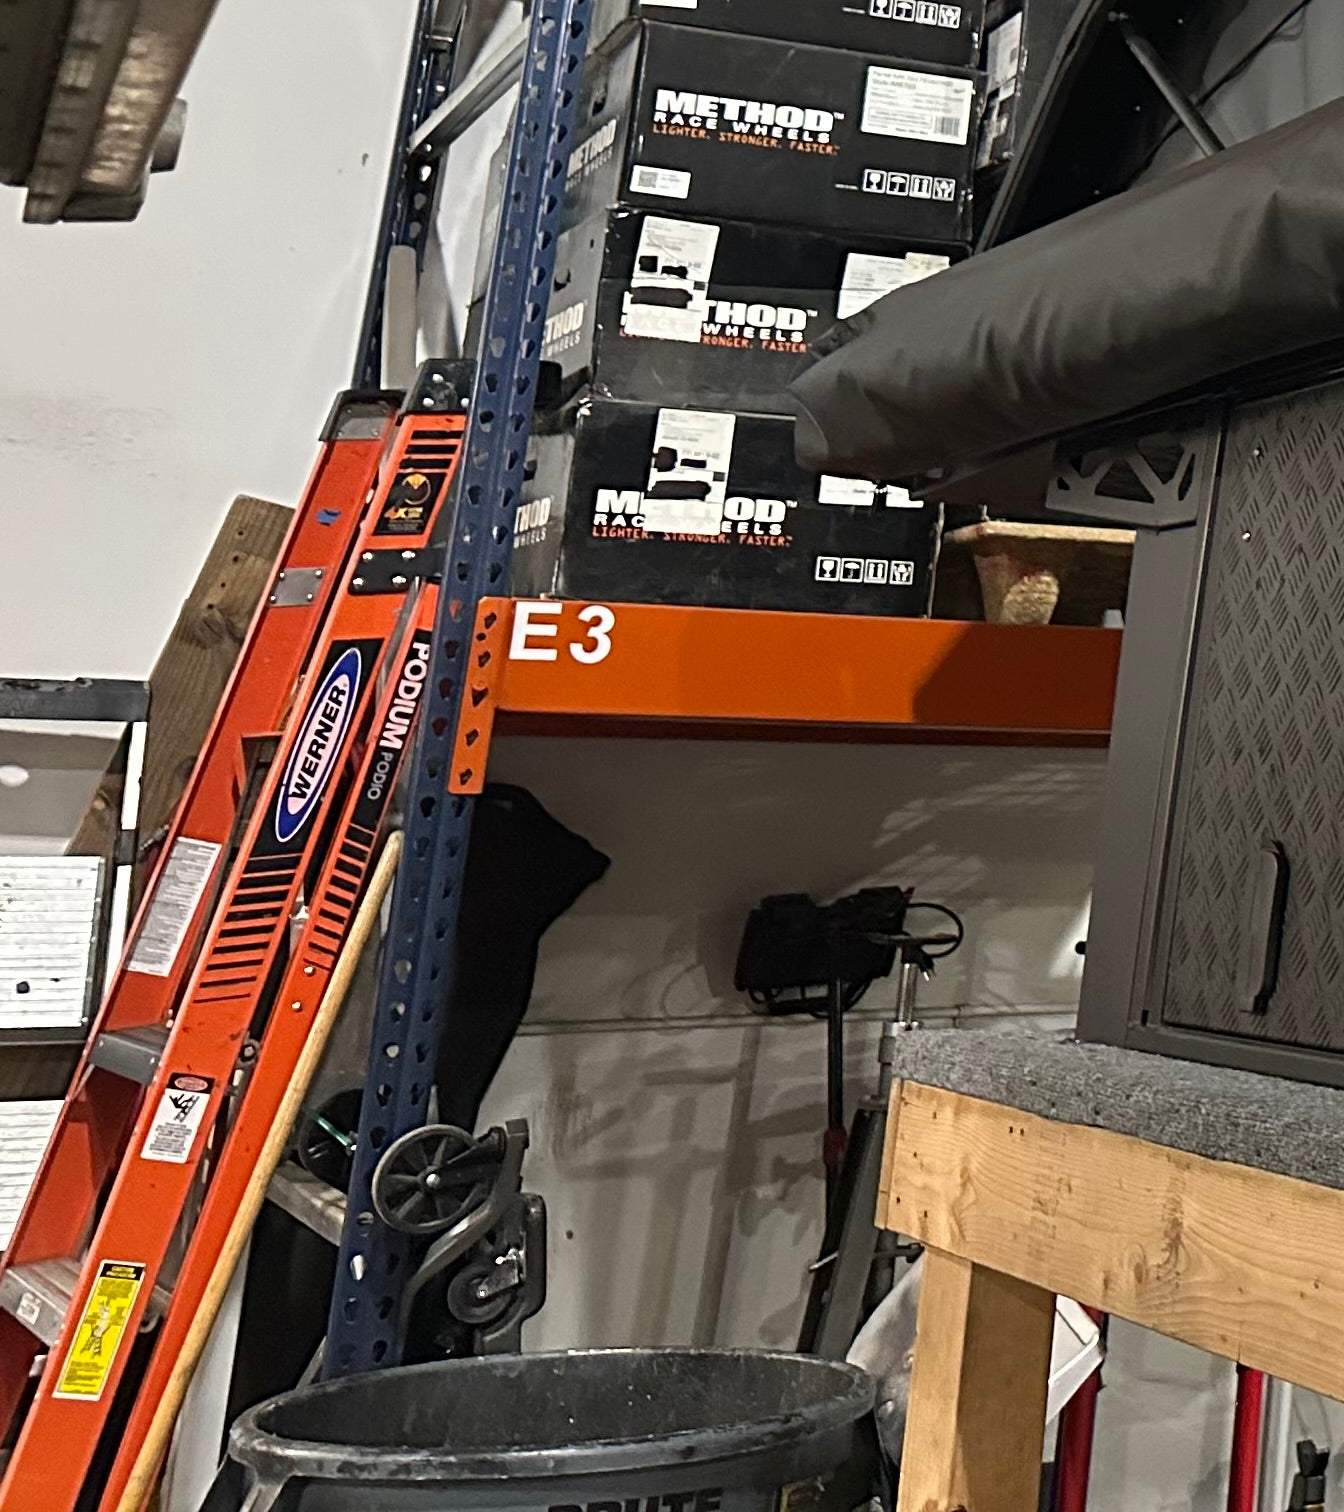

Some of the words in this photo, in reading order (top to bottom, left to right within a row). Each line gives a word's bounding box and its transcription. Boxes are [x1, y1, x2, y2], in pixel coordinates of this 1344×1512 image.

[653, 111, 718, 131] RACE
[732, 122, 831, 145] WHEELS
[703, 323, 805, 343] WHEELS
[593, 513, 646, 528] RAC
[721, 519, 784, 537] EELS
[379, 641, 432, 750] PODIUM
[288, 685, 348, 802] WERNER
[367, 751, 395, 801] PODIO
